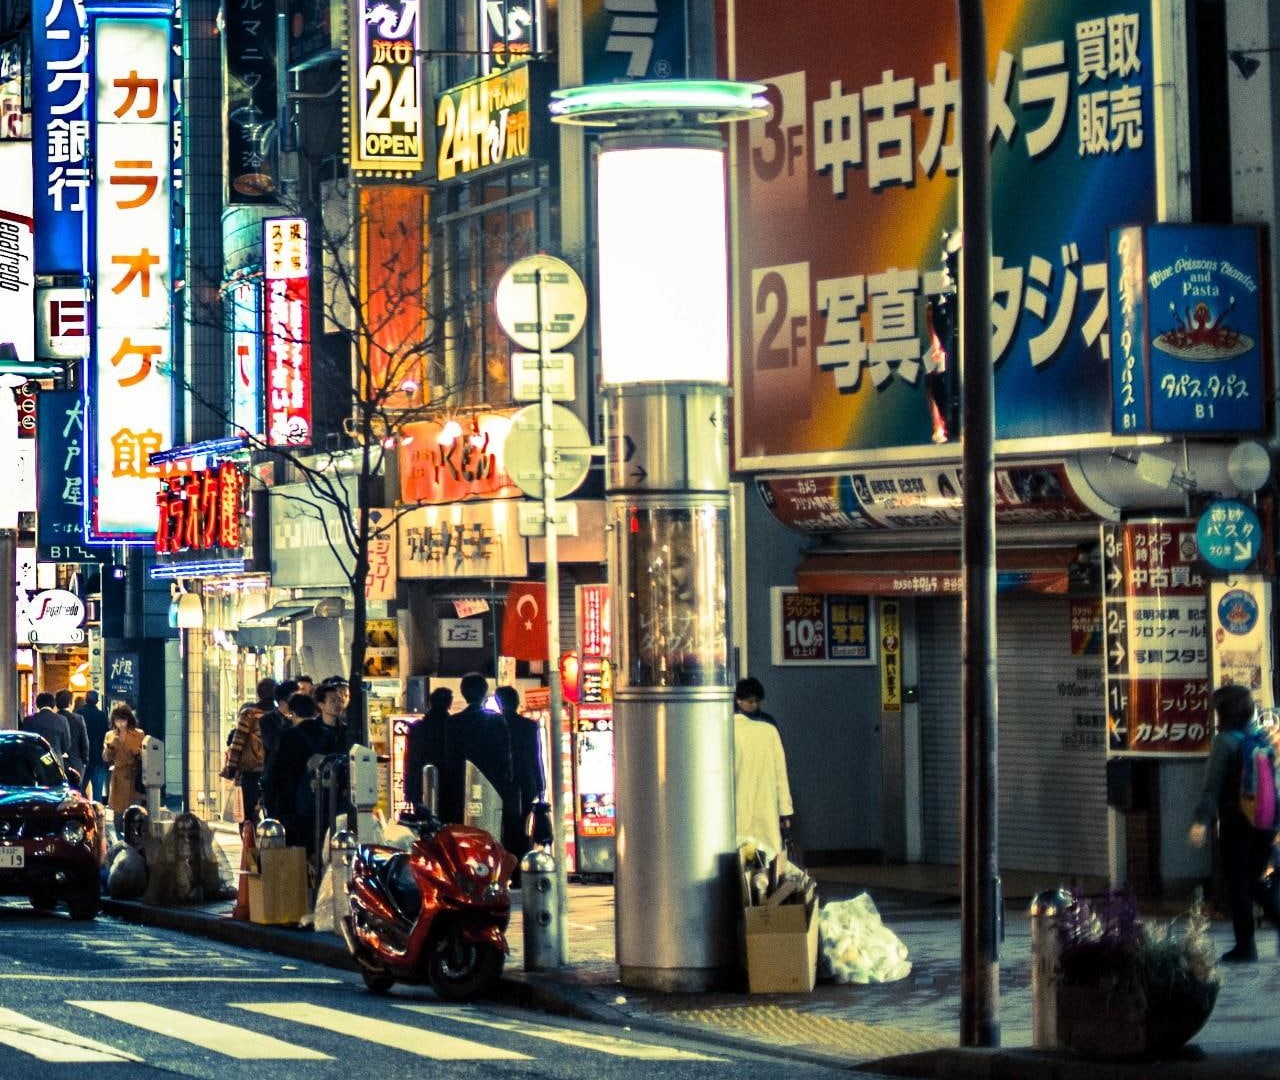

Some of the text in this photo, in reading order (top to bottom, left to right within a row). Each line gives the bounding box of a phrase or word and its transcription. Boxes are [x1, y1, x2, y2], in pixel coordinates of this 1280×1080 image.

[1075, 12, 1142, 86] 買取
[366, 65, 418, 133] 24
[813, 40, 1072, 197] 中古カメラ
[1077, 85, 1144, 158] 販売
[366, 134, 418, 155] OPEN
[109, 69, 163, 479] カラオケ館
[1190, 271, 1211, 282] and
[1182, 282, 1220, 297] Pasta
[755, 270, 808, 372] 2F
[63, 400, 83, 506] 大戸屋
[1105, 533, 1124, 563] 3F
[1135, 532, 1172, 550] カメラ
[1135, 551, 1167, 567] 時計
[785, 618, 815, 647] 10
[1107, 609, 1127, 635] 2F
[1110, 686, 1129, 711] 1F
